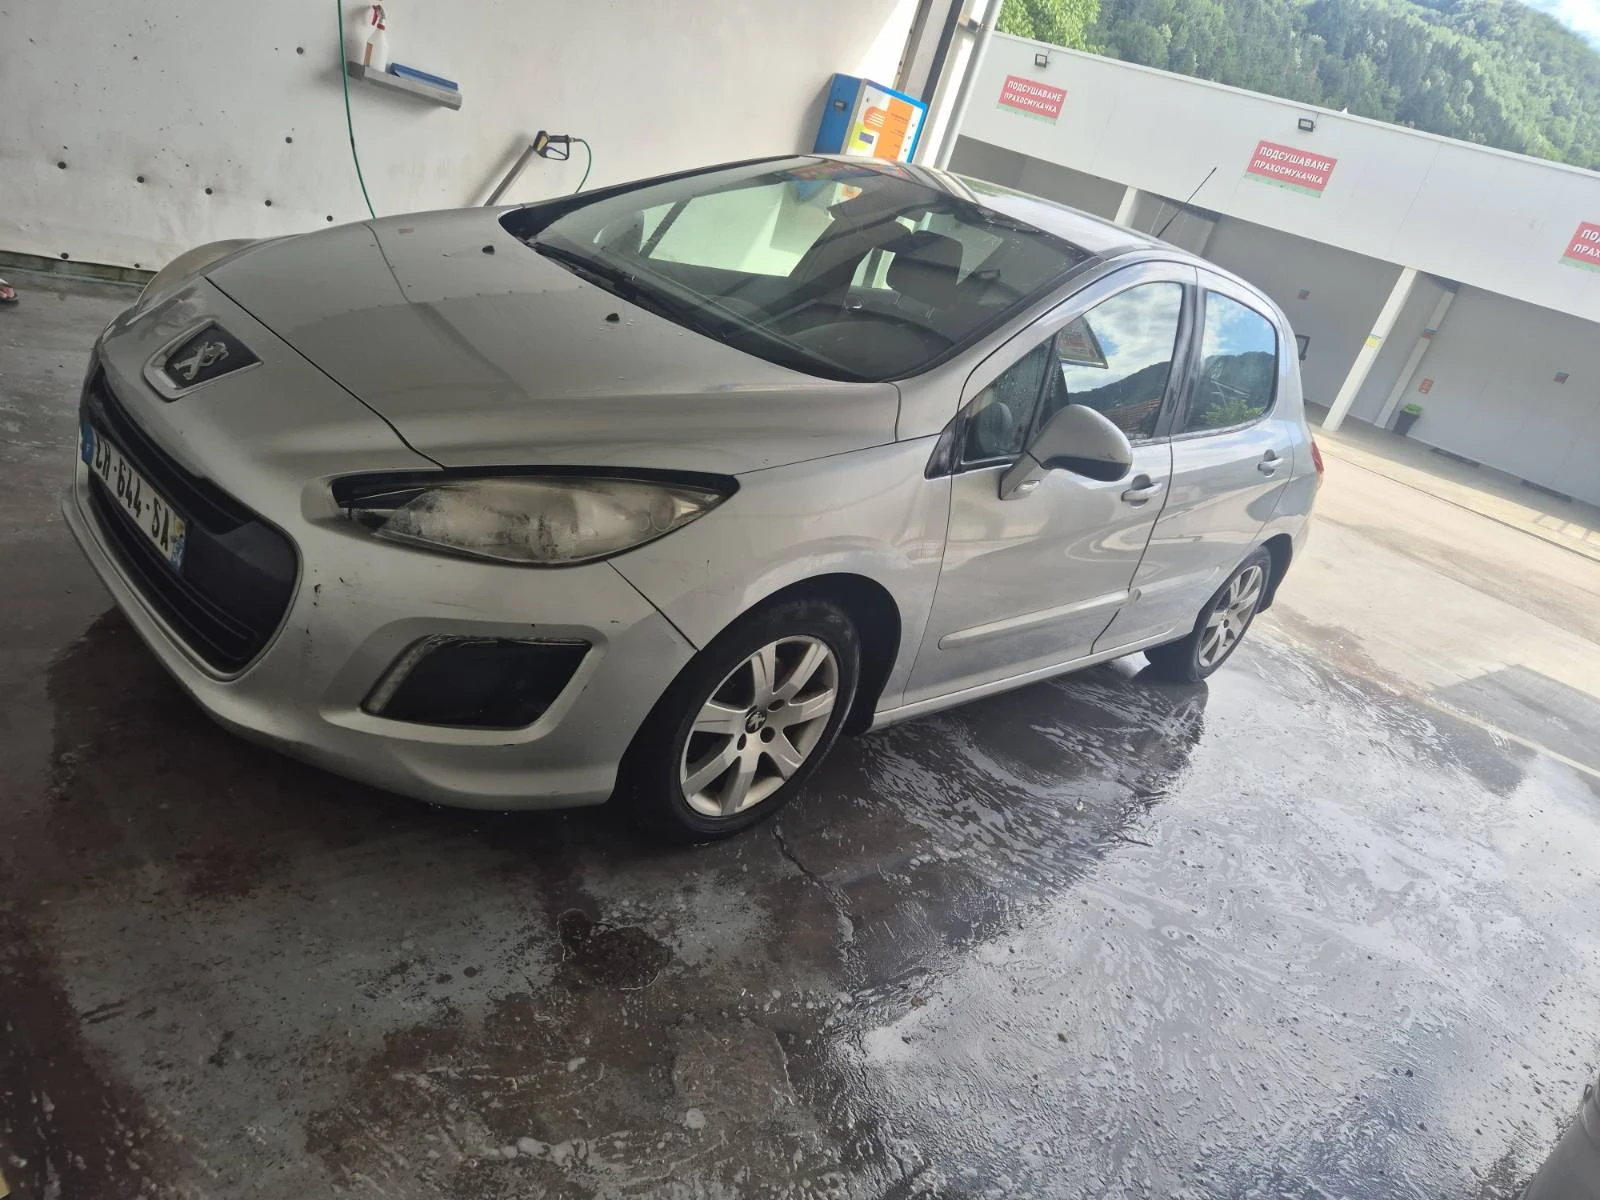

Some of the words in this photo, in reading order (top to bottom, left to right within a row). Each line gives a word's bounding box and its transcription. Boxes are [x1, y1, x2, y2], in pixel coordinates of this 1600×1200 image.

[1004, 92, 1057, 113] ПРАХОСМУКАЧКА
[1008, 80, 1062, 102] ПОДСУШАВАНЕ
[1260, 146, 1331, 172] ПОДСУШАВАНЕ
[1254, 159, 1323, 184] ПРАХОСМУКАЧКА
